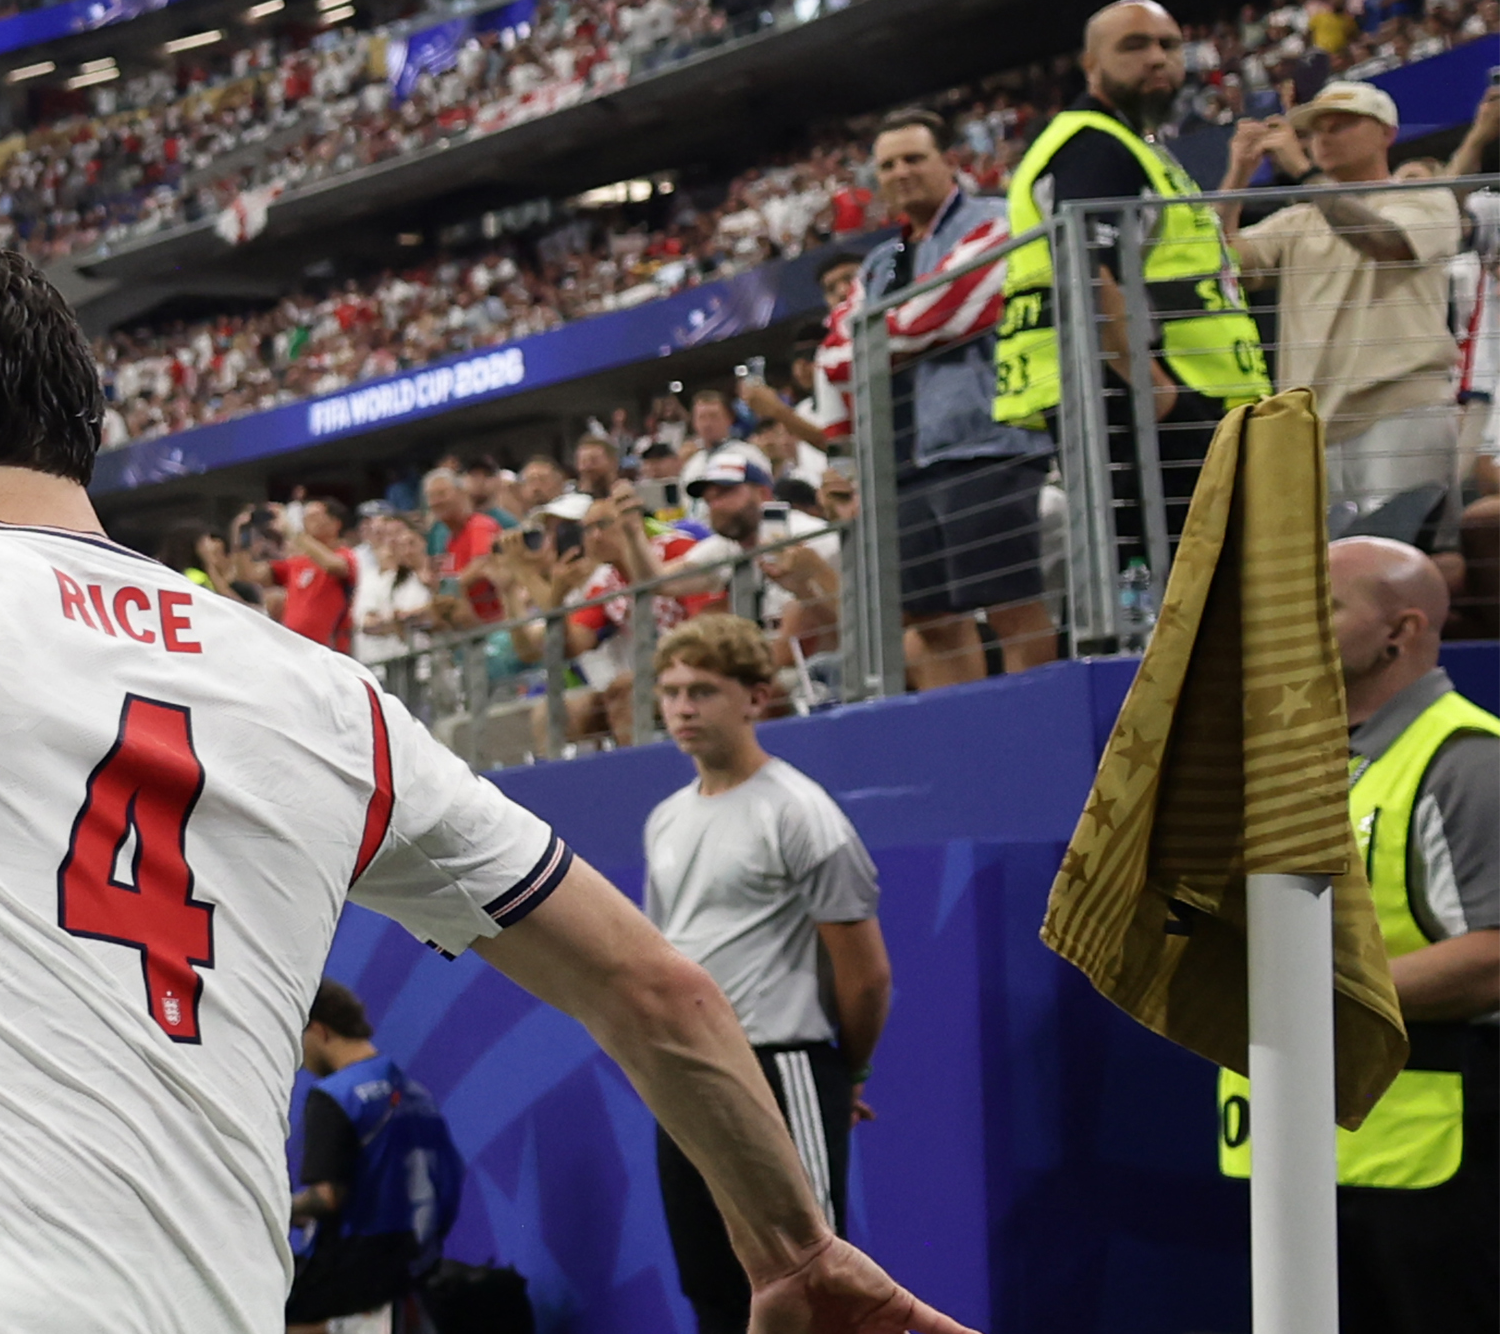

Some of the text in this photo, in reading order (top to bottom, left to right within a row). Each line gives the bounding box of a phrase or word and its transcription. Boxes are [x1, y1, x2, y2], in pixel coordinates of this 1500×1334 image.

[308, 347, 526, 436] FIFA WORLD CUP 2026
[51, 565, 203, 654] RICE
[57, 692, 216, 1045] 4
